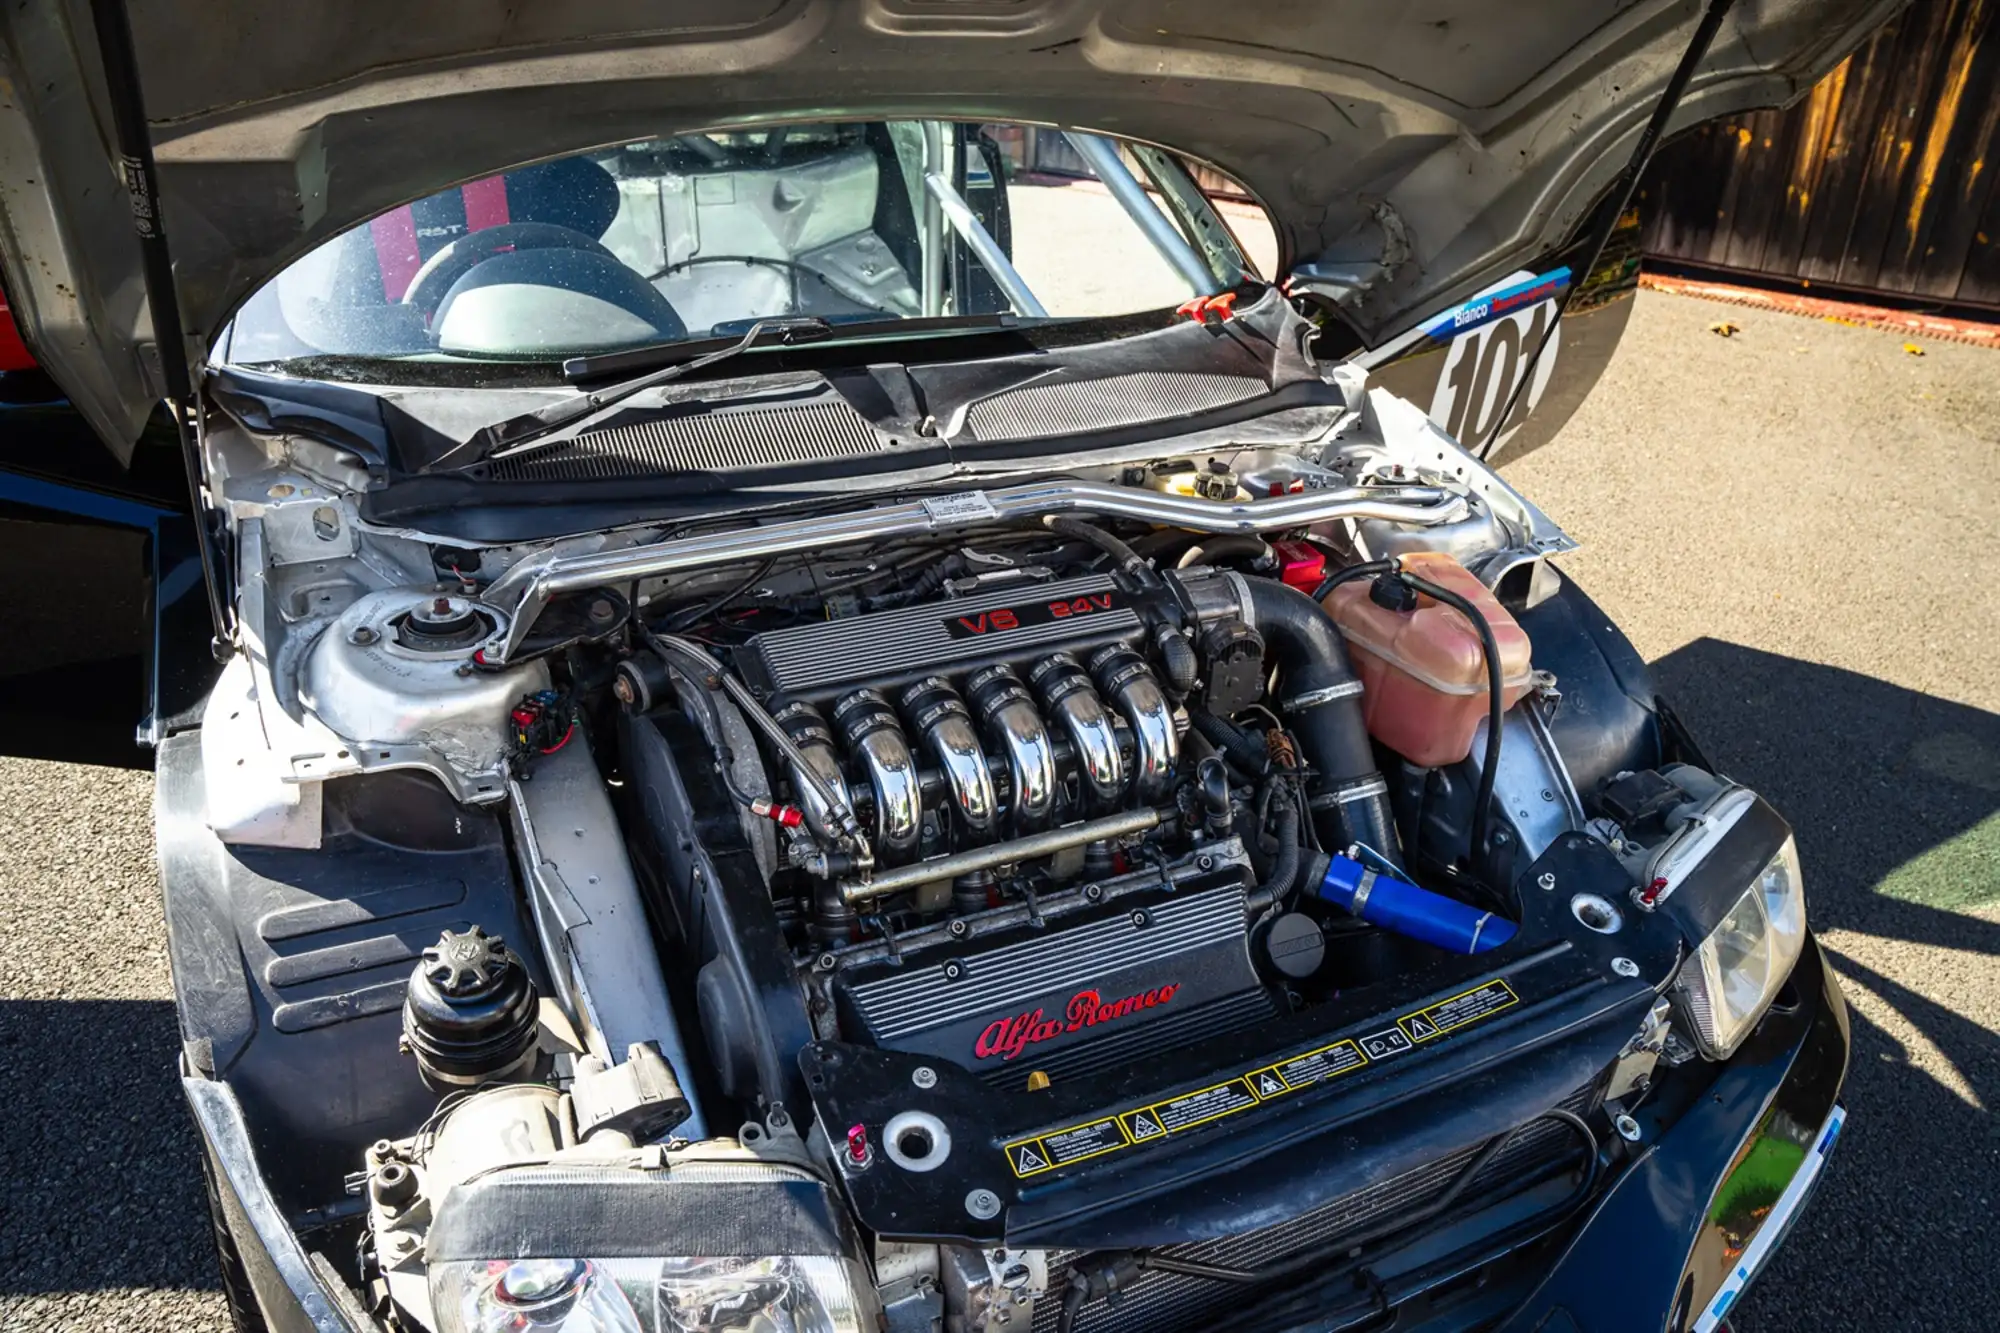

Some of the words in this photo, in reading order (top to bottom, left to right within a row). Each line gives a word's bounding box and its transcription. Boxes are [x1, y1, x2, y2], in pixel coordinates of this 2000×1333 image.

[1453, 303, 1488, 328] Bianco
[1446, 302, 1547, 450] 101
[958, 608, 1019, 634] V6
[1048, 592, 1112, 618] 24V
[975, 1007, 1064, 1061] Alfa
[1065, 987, 1181, 1032] Romeo
